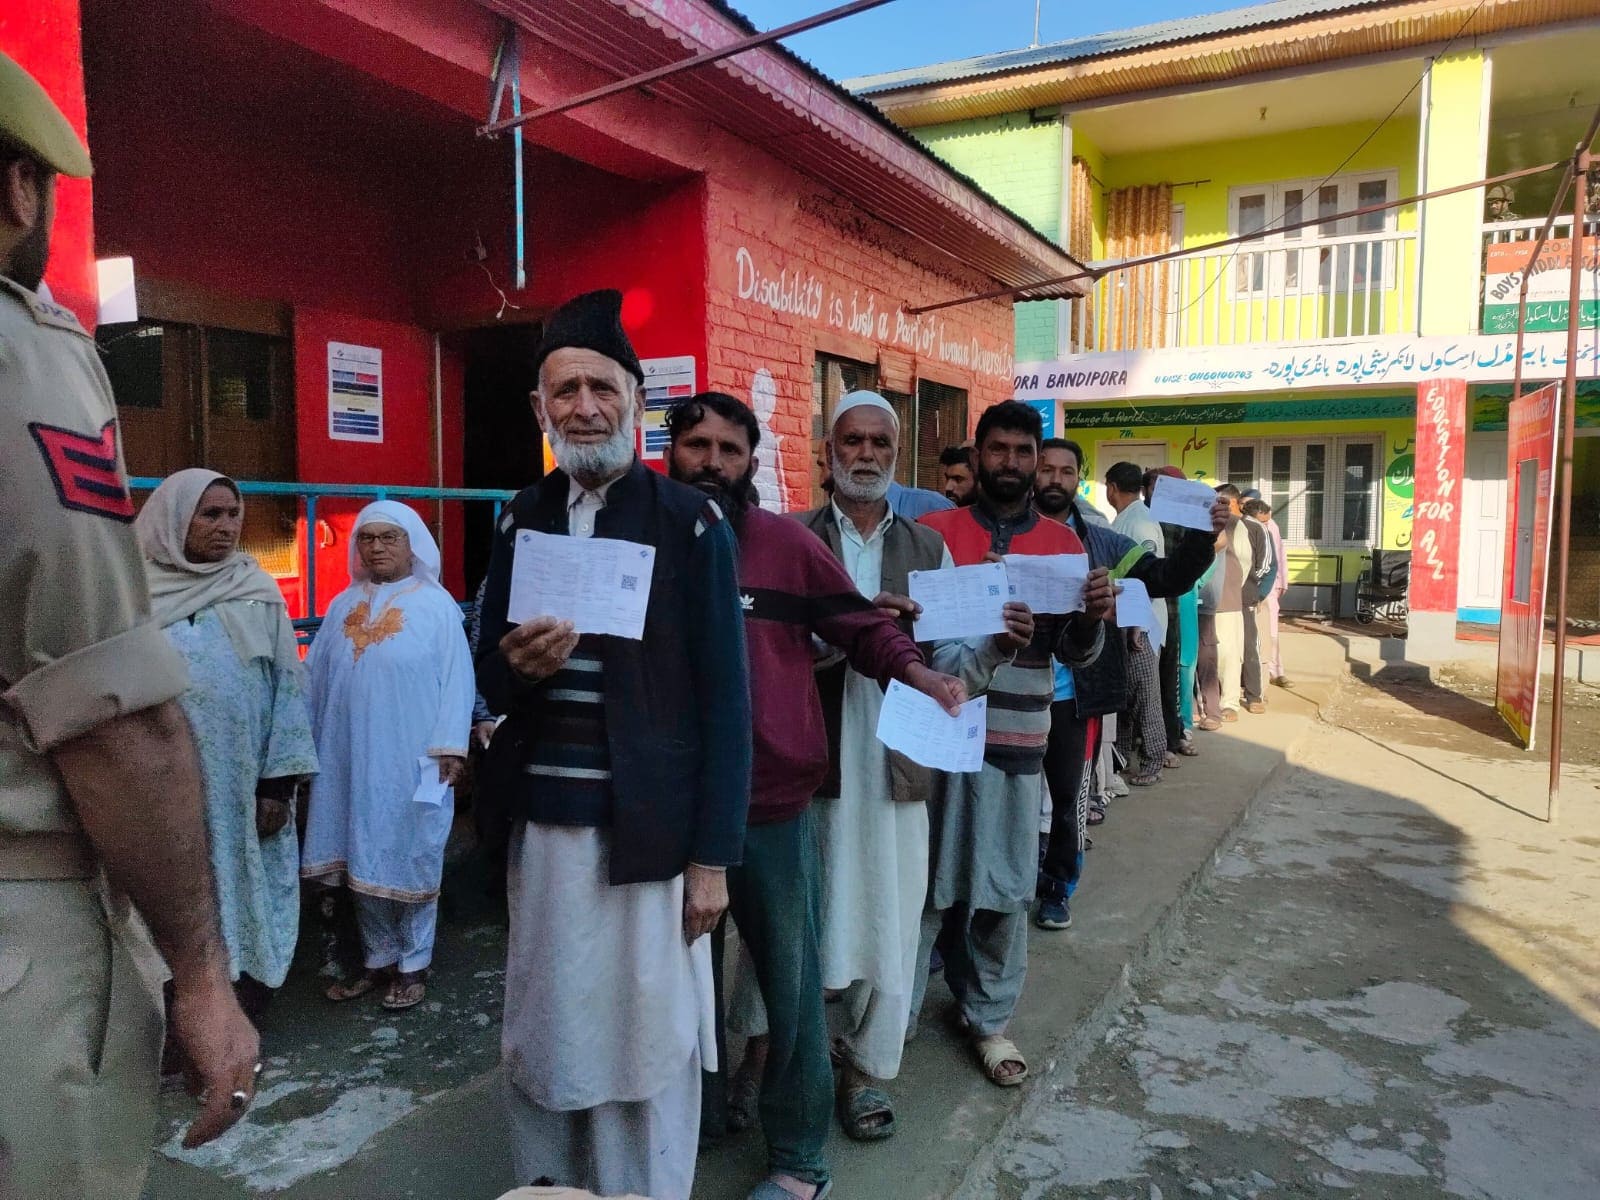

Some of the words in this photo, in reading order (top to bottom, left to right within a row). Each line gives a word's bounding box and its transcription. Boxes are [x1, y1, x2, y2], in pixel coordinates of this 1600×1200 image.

[1490, 272, 1521, 300] BOYS
[736, 245, 823, 320] Disability
[829, 295, 843, 328] is
[877, 311, 889, 340] a
[922, 315, 936, 358] of
[1046, 370, 1128, 389] BANDIPORA
[1416, 501, 1454, 522] FOR
[1420, 529, 1445, 581] ALL
